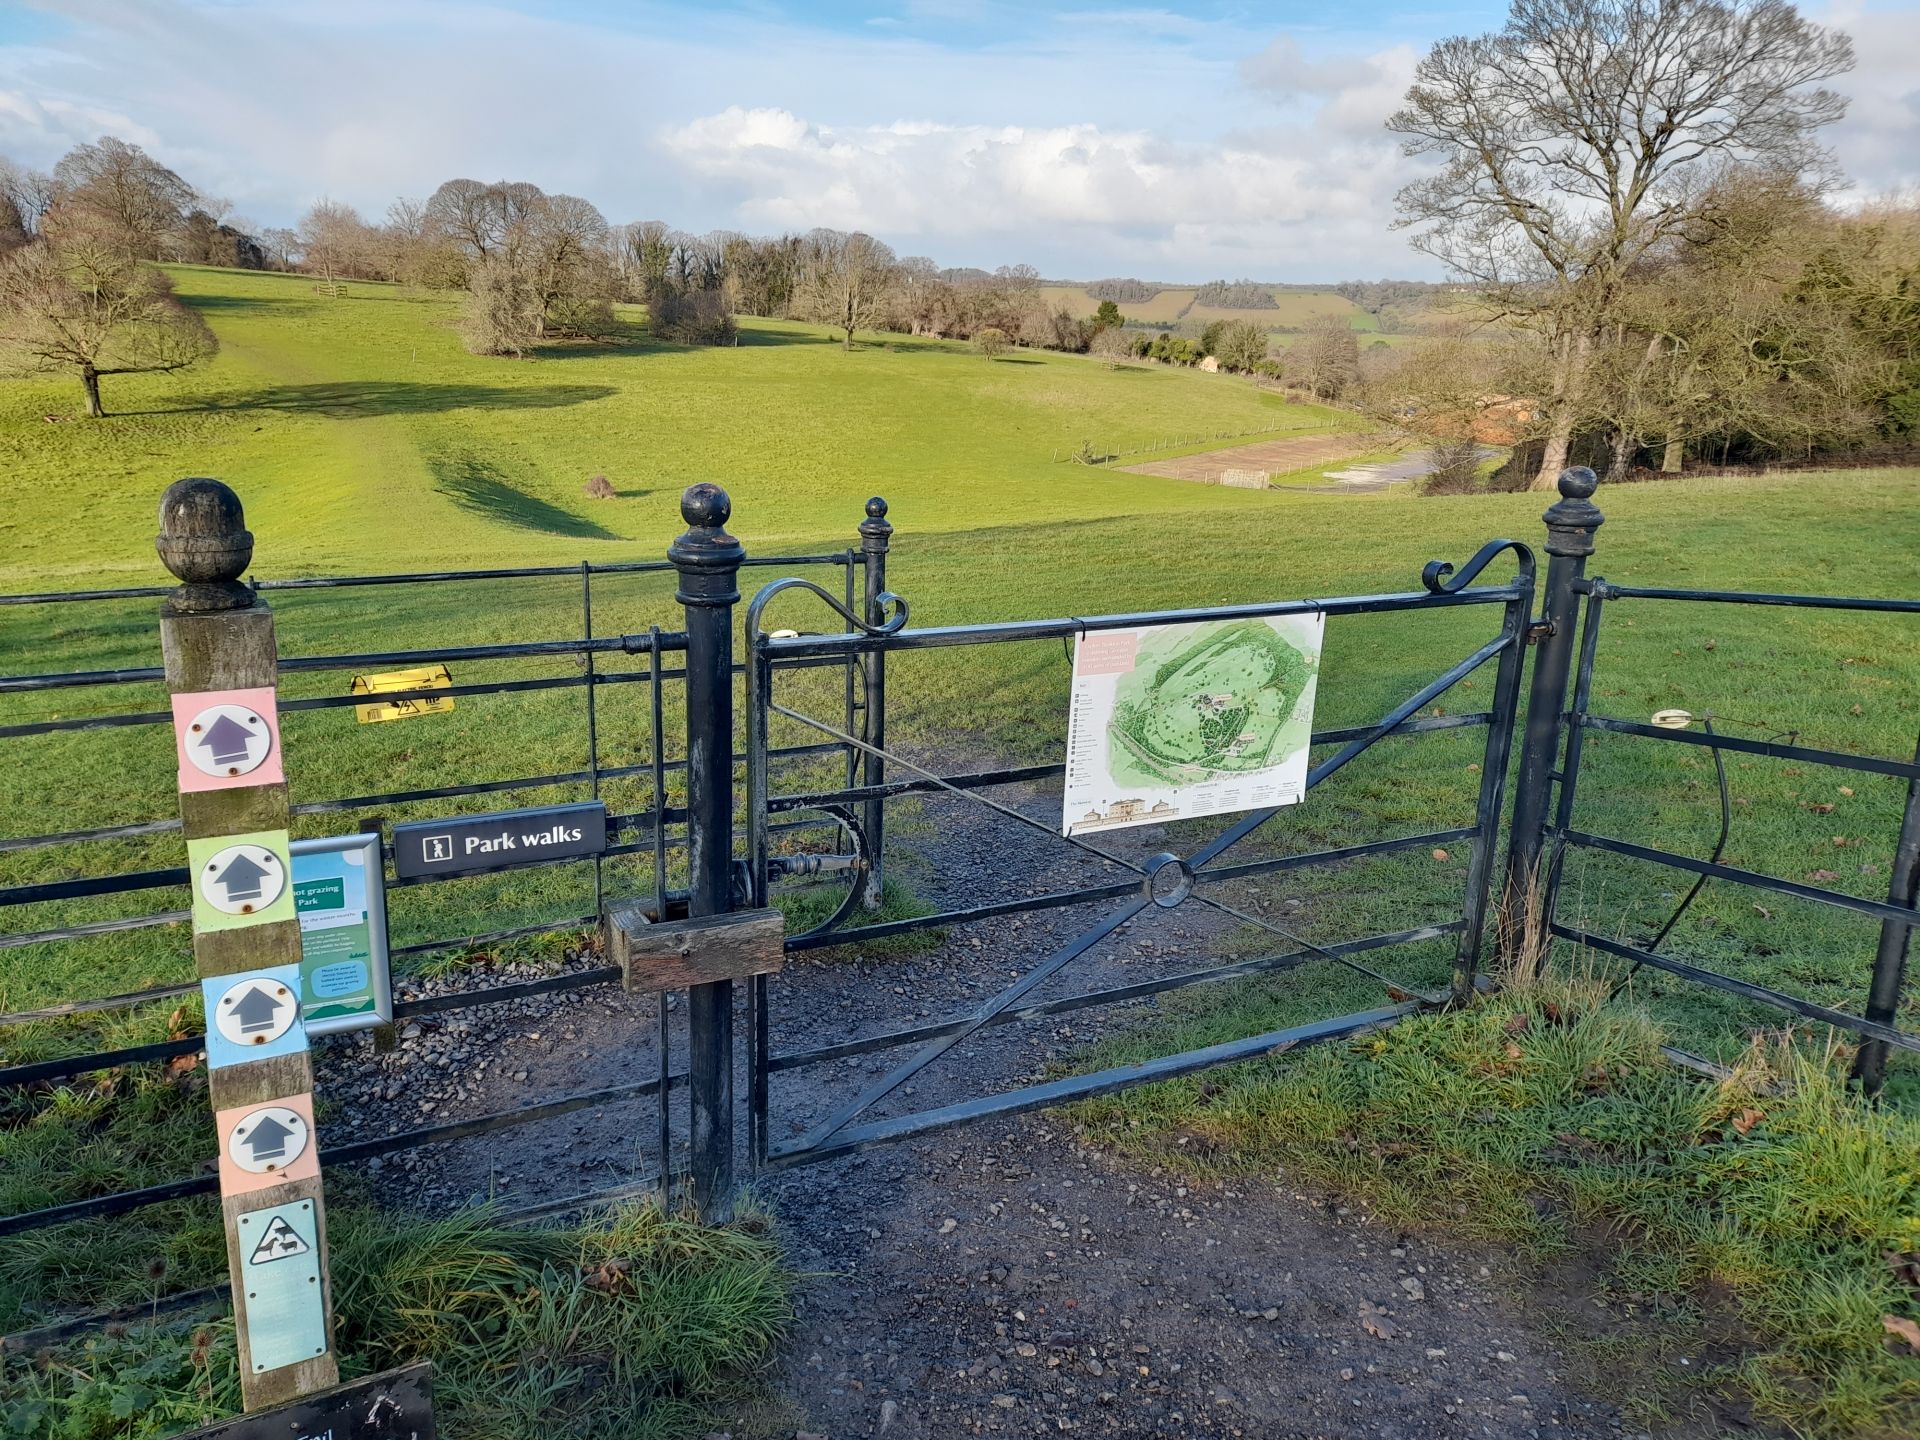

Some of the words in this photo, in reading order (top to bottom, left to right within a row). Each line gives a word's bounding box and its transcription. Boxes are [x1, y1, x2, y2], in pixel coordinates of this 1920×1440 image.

[465, 832, 516, 855] Park
[522, 826, 582, 847] walks
[307, 885, 339, 896] grazing
[298, 898, 318, 906] Park
[297, 1429, 333, 1440] ail
